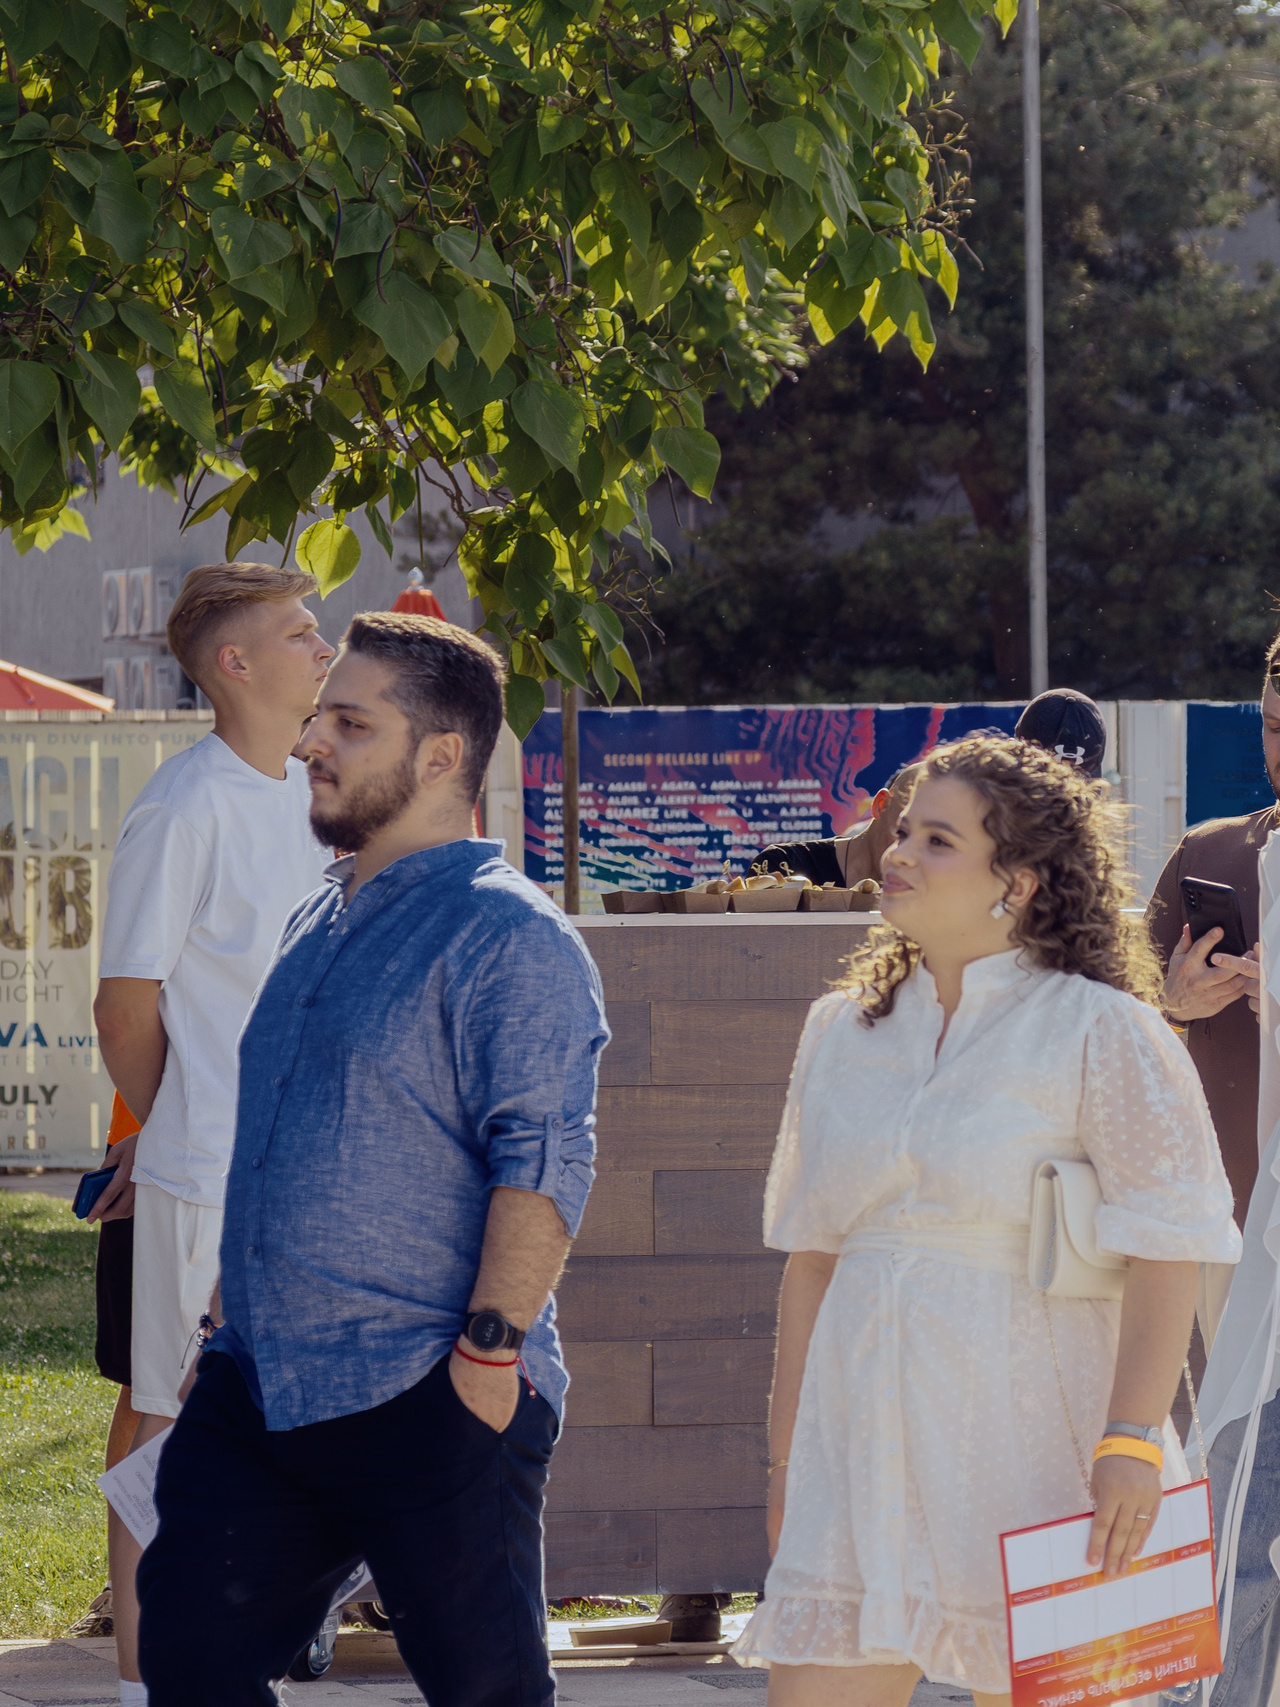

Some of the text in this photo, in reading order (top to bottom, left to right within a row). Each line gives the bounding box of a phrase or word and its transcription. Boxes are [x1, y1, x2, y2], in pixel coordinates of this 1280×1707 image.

[102, 733, 149, 746] INTO
[603, 751, 761, 767] SECOND RELEASE LINE UP
[0, 960, 55, 980] DAY
[0, 984, 64, 1003] IGHT
[1154, 1655, 1198, 1682] ЛЕТНИЙ
[1087, 1668, 1153, 1699] ФЕСТИВАЛЬ
